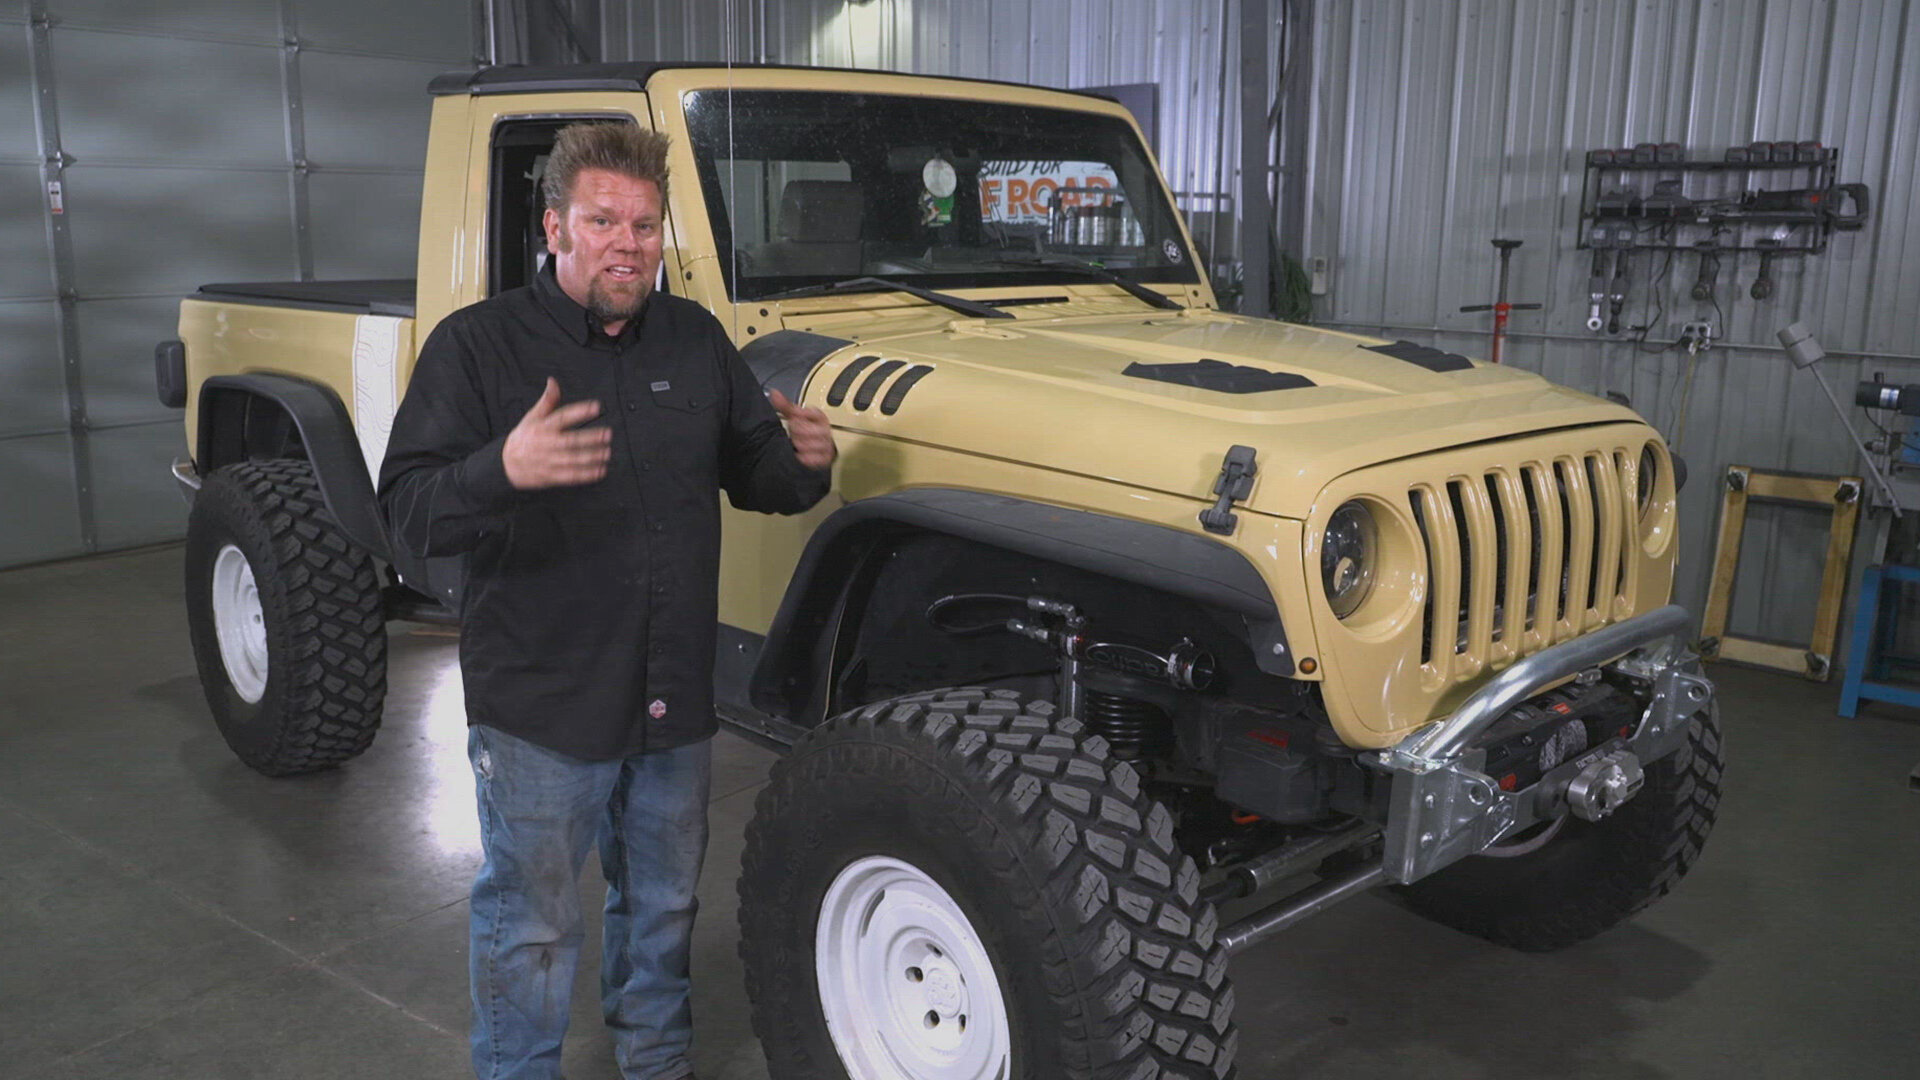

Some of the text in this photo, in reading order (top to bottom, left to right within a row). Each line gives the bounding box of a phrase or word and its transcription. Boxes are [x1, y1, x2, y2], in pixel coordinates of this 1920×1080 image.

[980, 160, 1062, 176] BUILD FOR
[1007, 176, 1114, 216] ROAD
